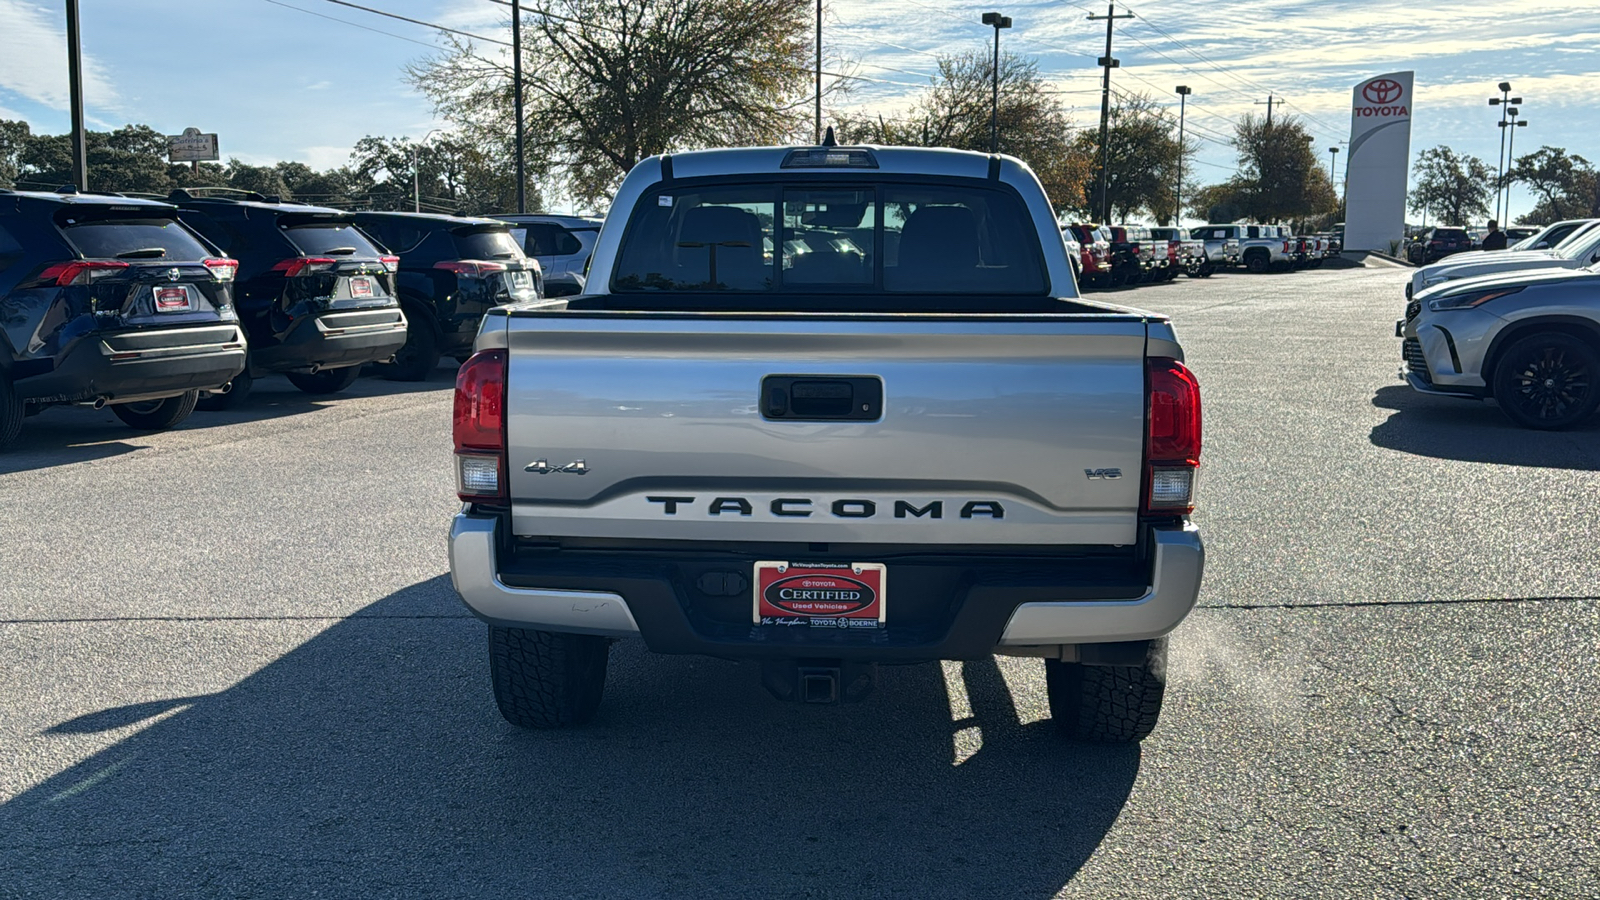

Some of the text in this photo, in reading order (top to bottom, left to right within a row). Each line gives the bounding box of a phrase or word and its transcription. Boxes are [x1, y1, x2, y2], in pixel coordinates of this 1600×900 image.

[1354, 105, 1408, 117] TOYOTA
[523, 458, 591, 475] 4x4
[1083, 467, 1122, 480] V6
[646, 495, 1005, 519] TACOMA
[779, 588, 861, 600] CERTIFIED
[849, 619, 878, 627] BOERNE
